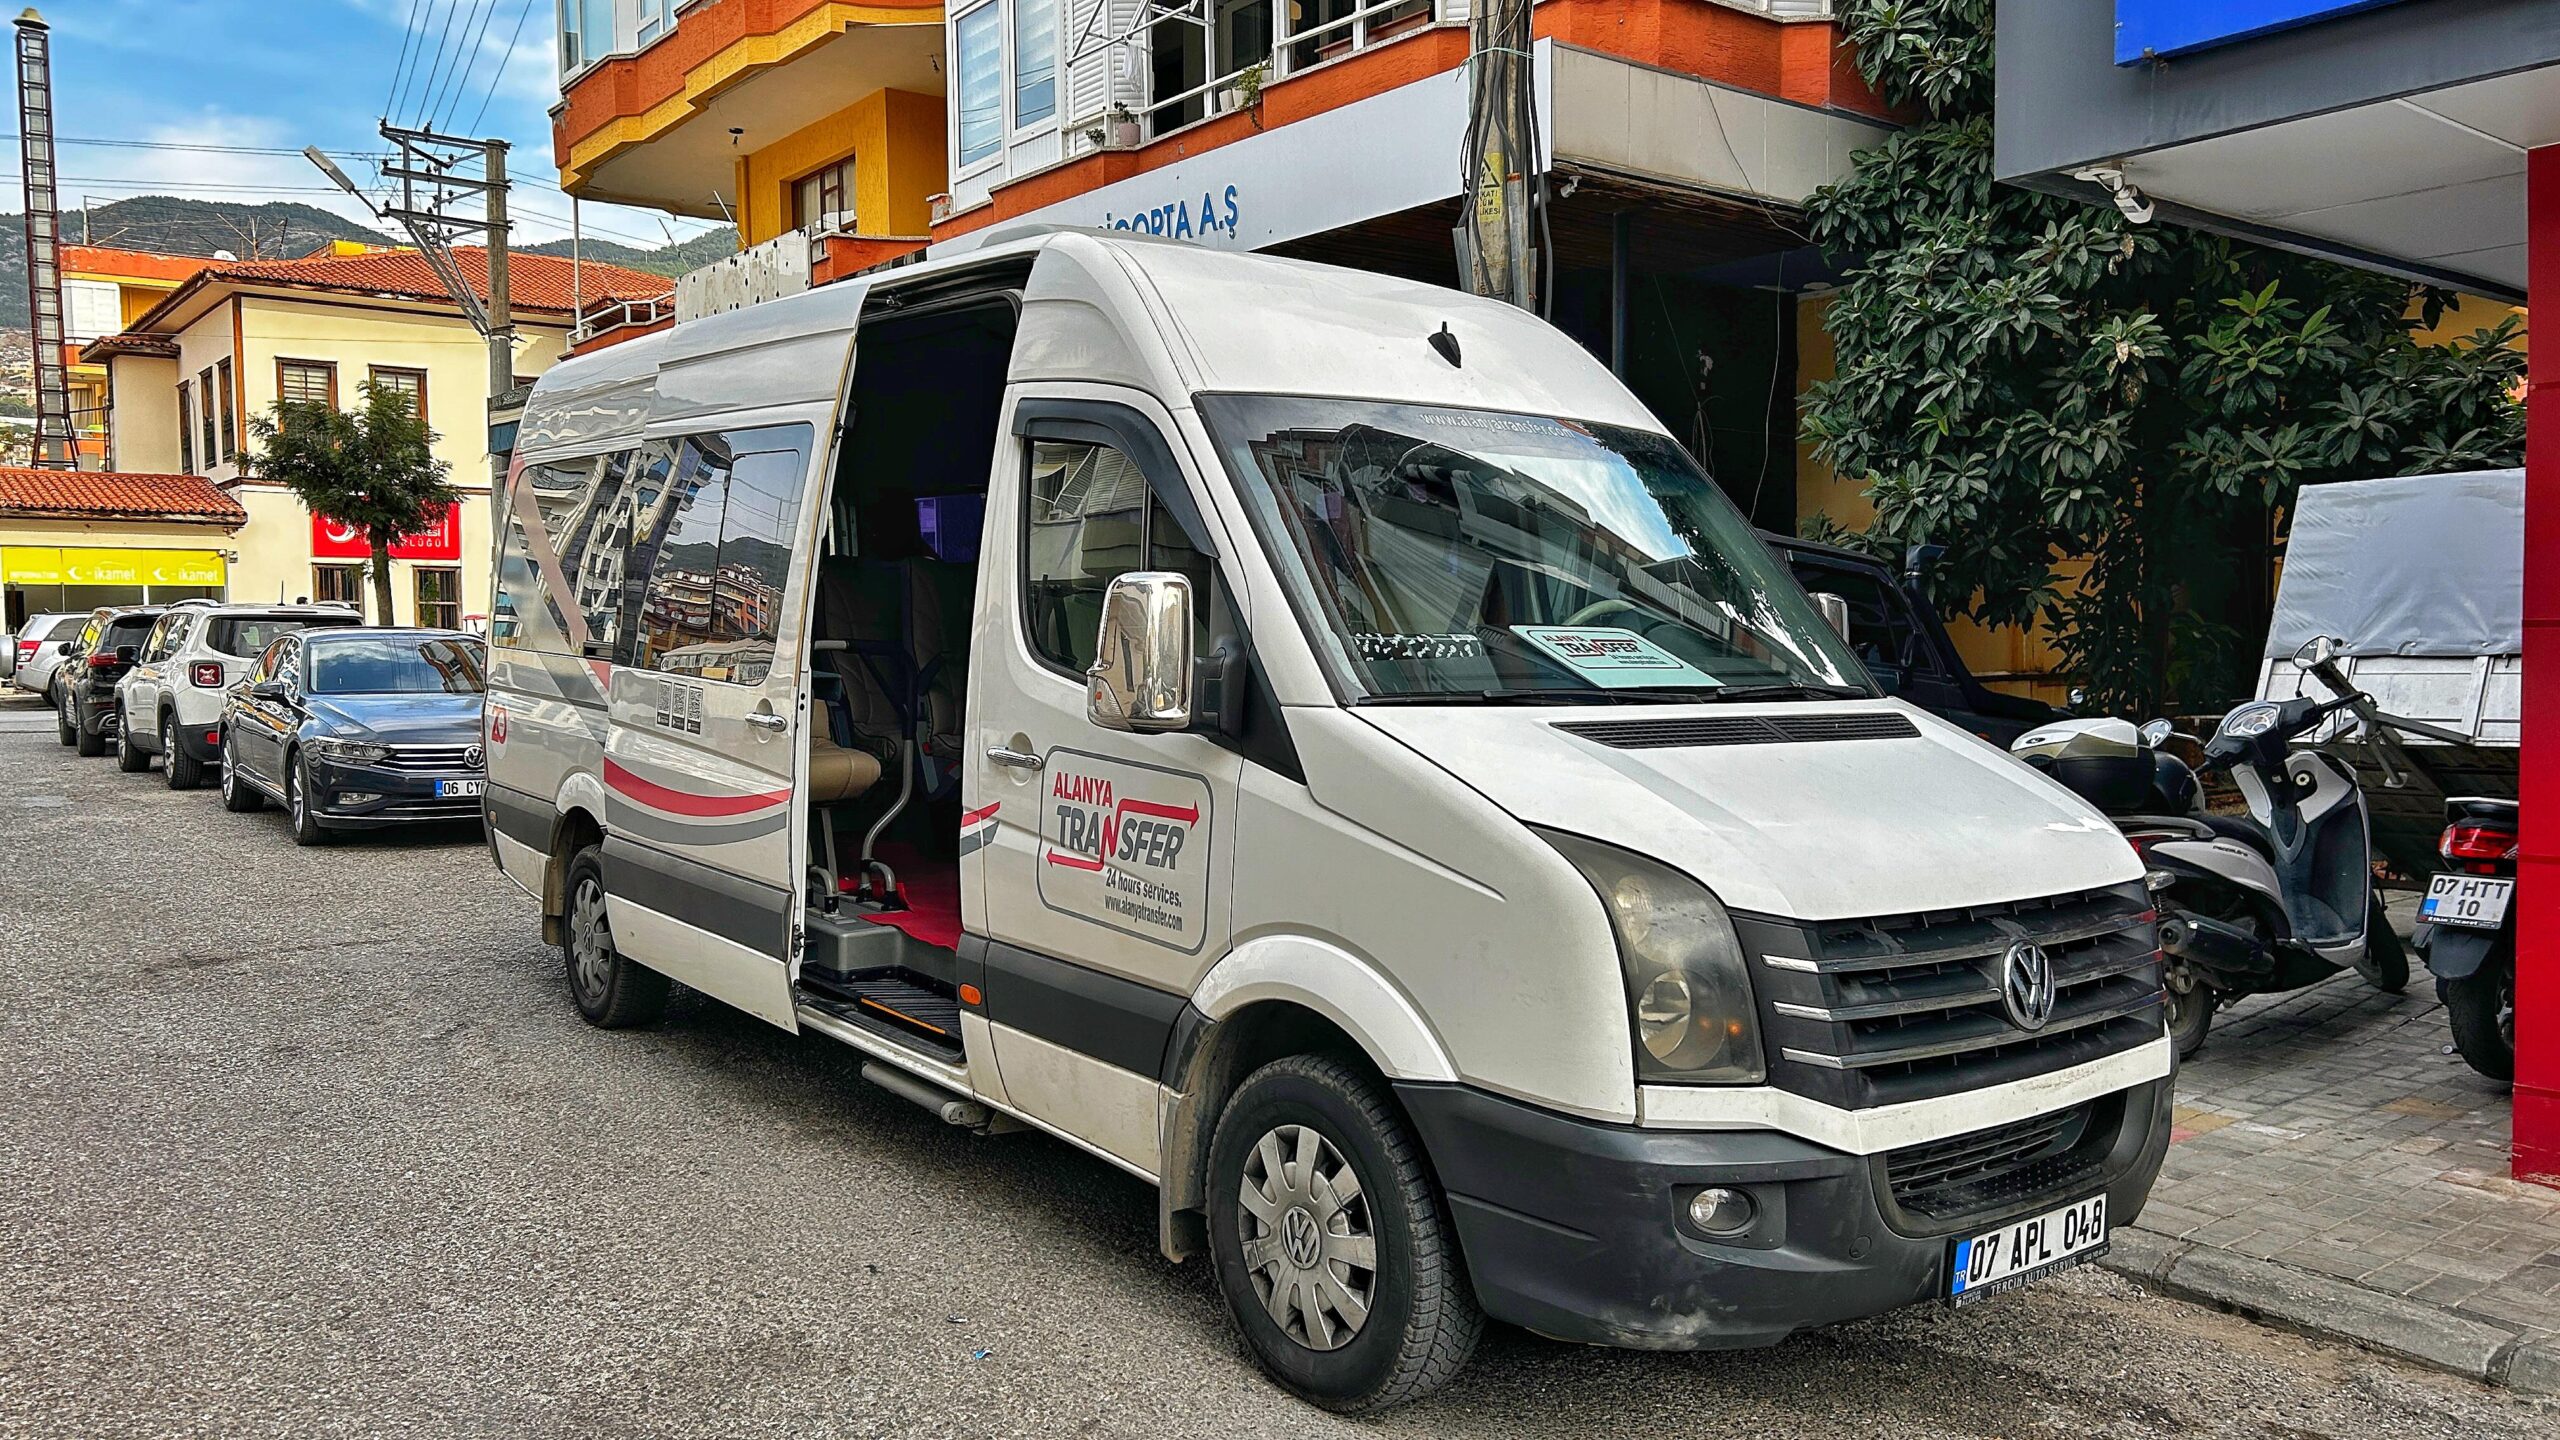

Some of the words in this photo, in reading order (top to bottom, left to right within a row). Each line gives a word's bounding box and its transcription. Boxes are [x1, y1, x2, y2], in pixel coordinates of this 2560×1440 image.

[1420, 413, 1576, 439] www.alanyatransfer.com
[1555, 642, 1643, 653] TRANSFER
[443, 782, 459, 795] 06
[1053, 772, 1113, 808] ALANYA
[1057, 804, 1185, 870] TRANSFER
[1106, 868, 1116, 888] 24
[1118, 871, 1141, 895] hours
[1143, 883, 1182, 908] services.
[2433, 878, 2460, 895] 07
[2461, 881, 2510, 899] HTT
[1105, 895, 1183, 932] www.alanyatransfer.com
[2457, 899, 2480, 917] 10
[1969, 1233, 2001, 1282] 07
[2010, 1218, 2052, 1271] APL
[2063, 1199, 2103, 1250] 048
[1955, 1269, 1967, 1284] TR
[2024, 1268, 2047, 1286] AUTO
